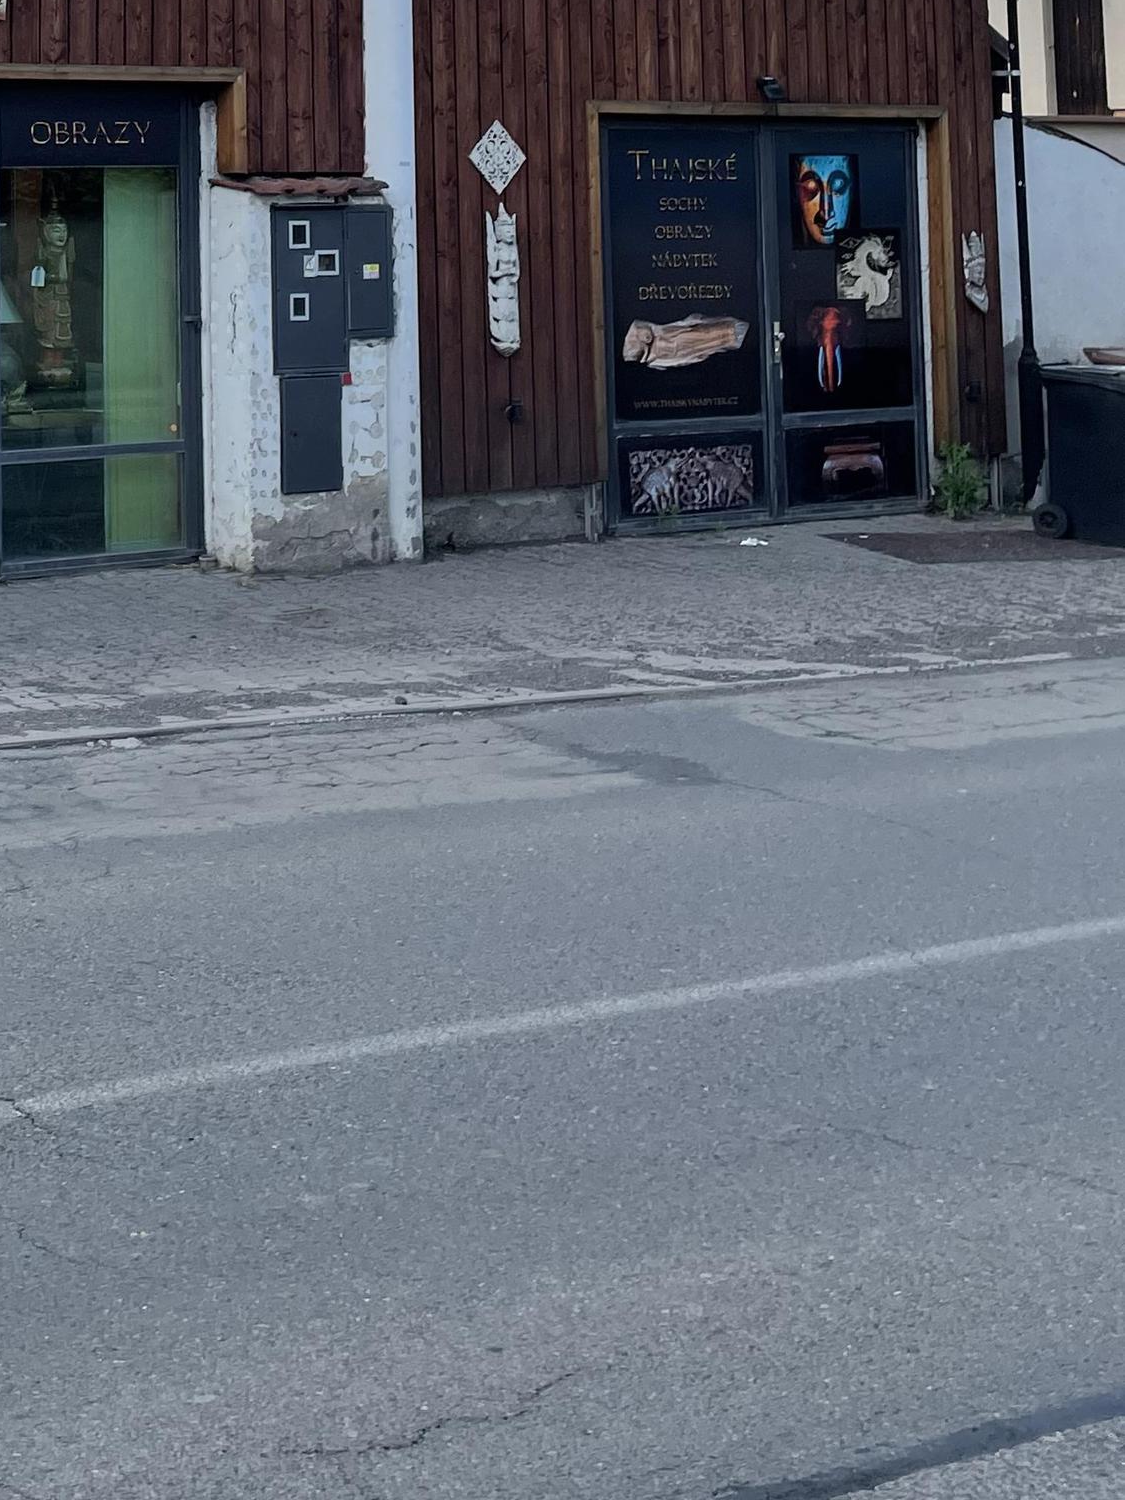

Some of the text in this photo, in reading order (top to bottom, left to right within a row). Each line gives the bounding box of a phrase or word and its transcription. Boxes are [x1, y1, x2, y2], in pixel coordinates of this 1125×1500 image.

[30, 119, 152, 146] OBRAZY
[659, 196, 708, 211] SOCHY
[654, 225, 714, 240] OBRAZY
[651, 251, 719, 268] NÁBYTEK
[638, 283, 734, 301] DŘEVOŘEZBY
